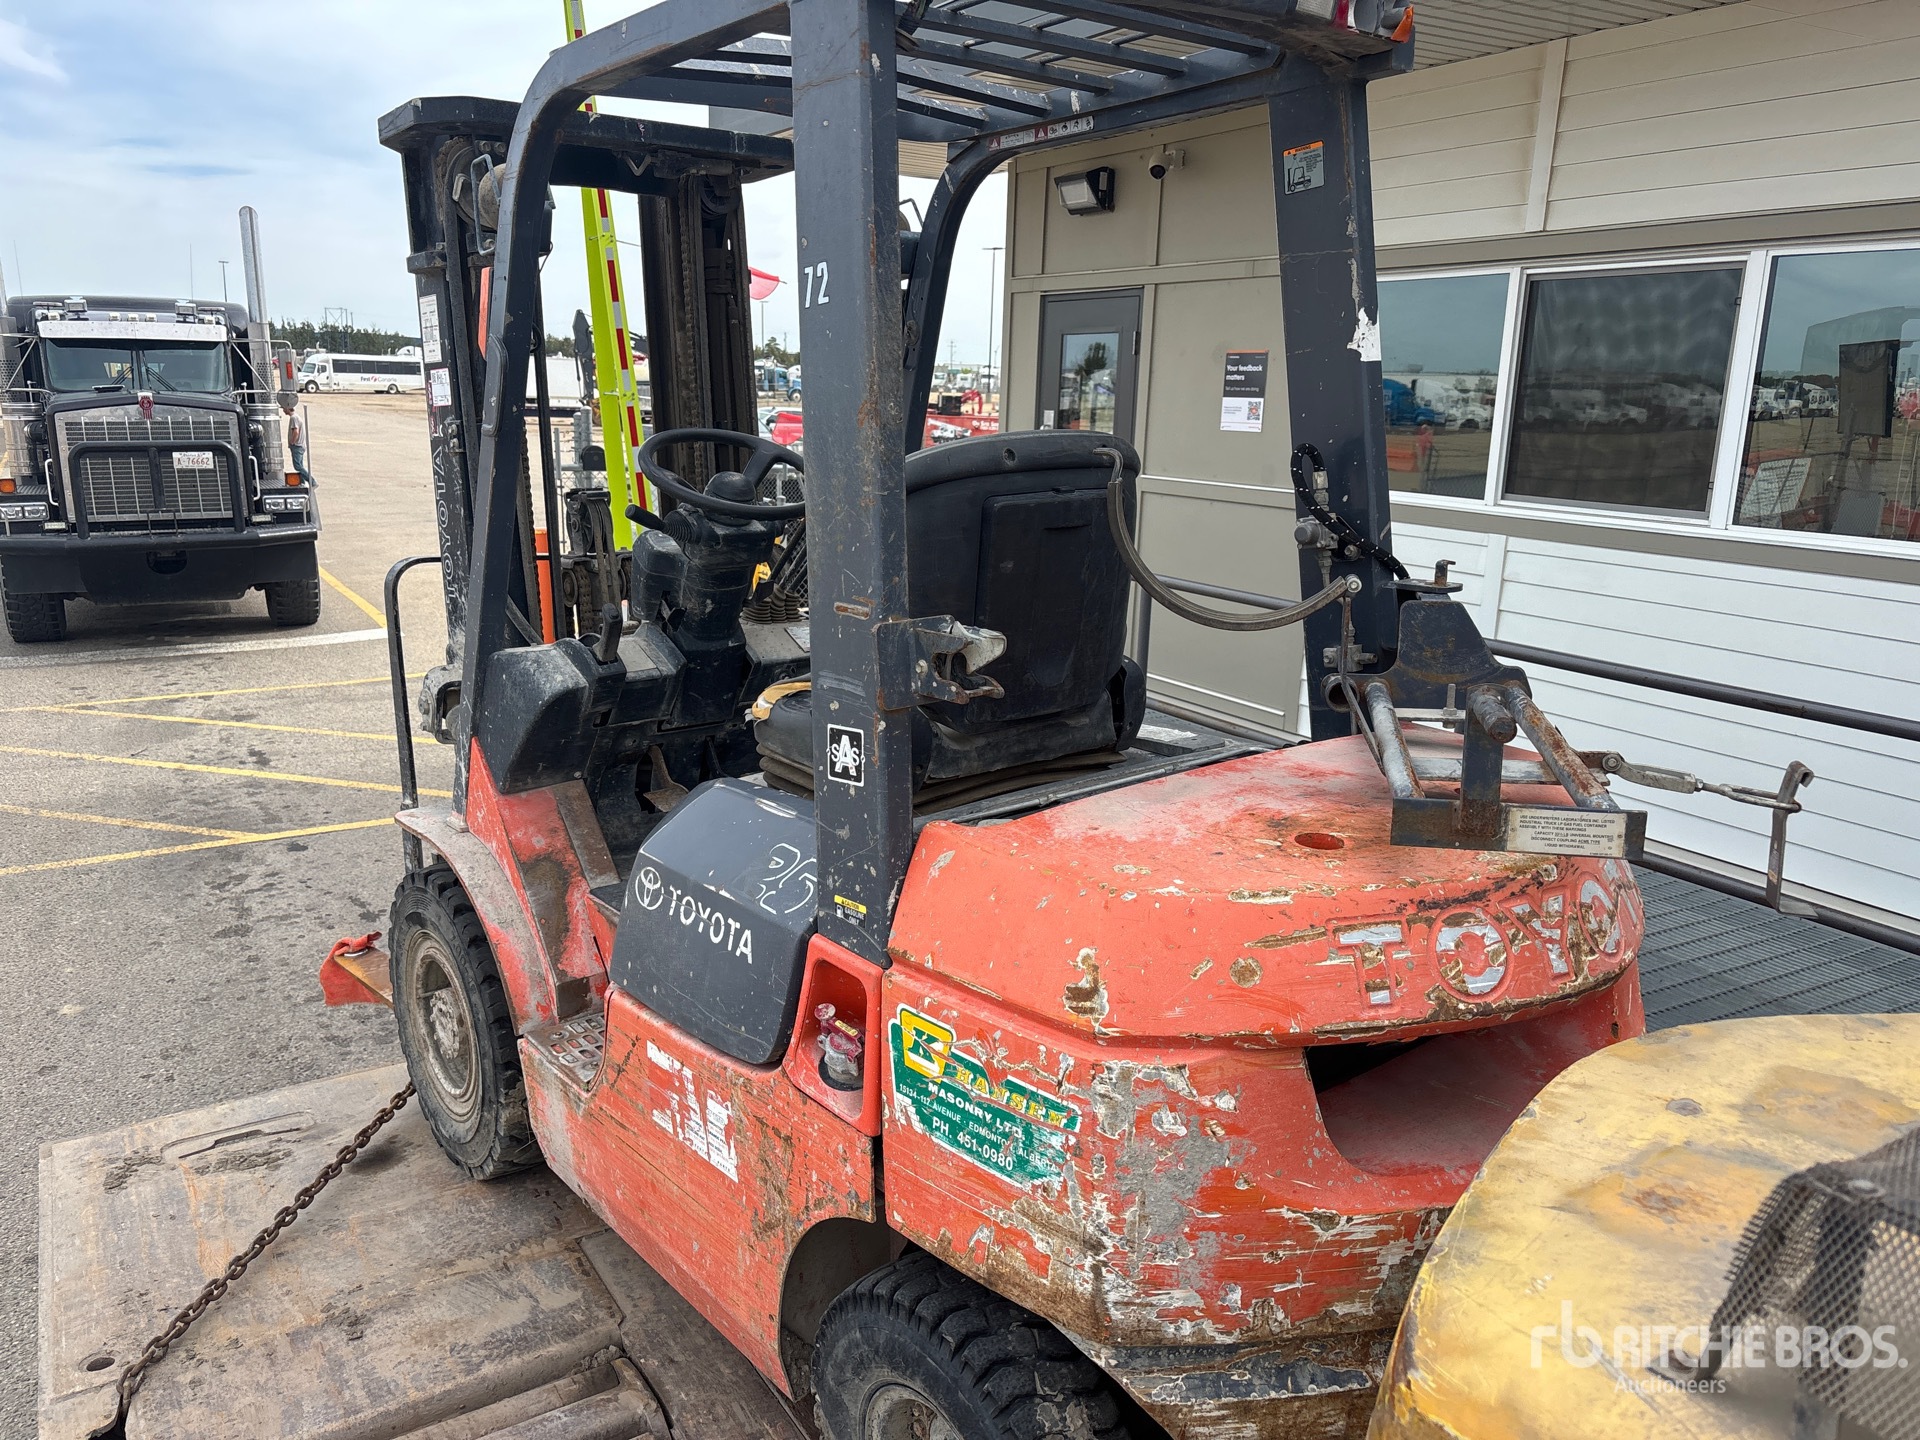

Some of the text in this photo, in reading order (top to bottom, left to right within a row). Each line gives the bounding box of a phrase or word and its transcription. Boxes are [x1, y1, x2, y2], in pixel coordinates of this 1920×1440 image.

[433, 446, 457, 603] TOYOTA
[669, 884, 753, 965] TOYOTA
[928, 1081, 993, 1123] MASONRY
[932, 1102, 962, 1123] AVENUE
[955, 1066, 1066, 1127] HANSEN
[932, 1116, 1013, 1171] PH. 451-0980
